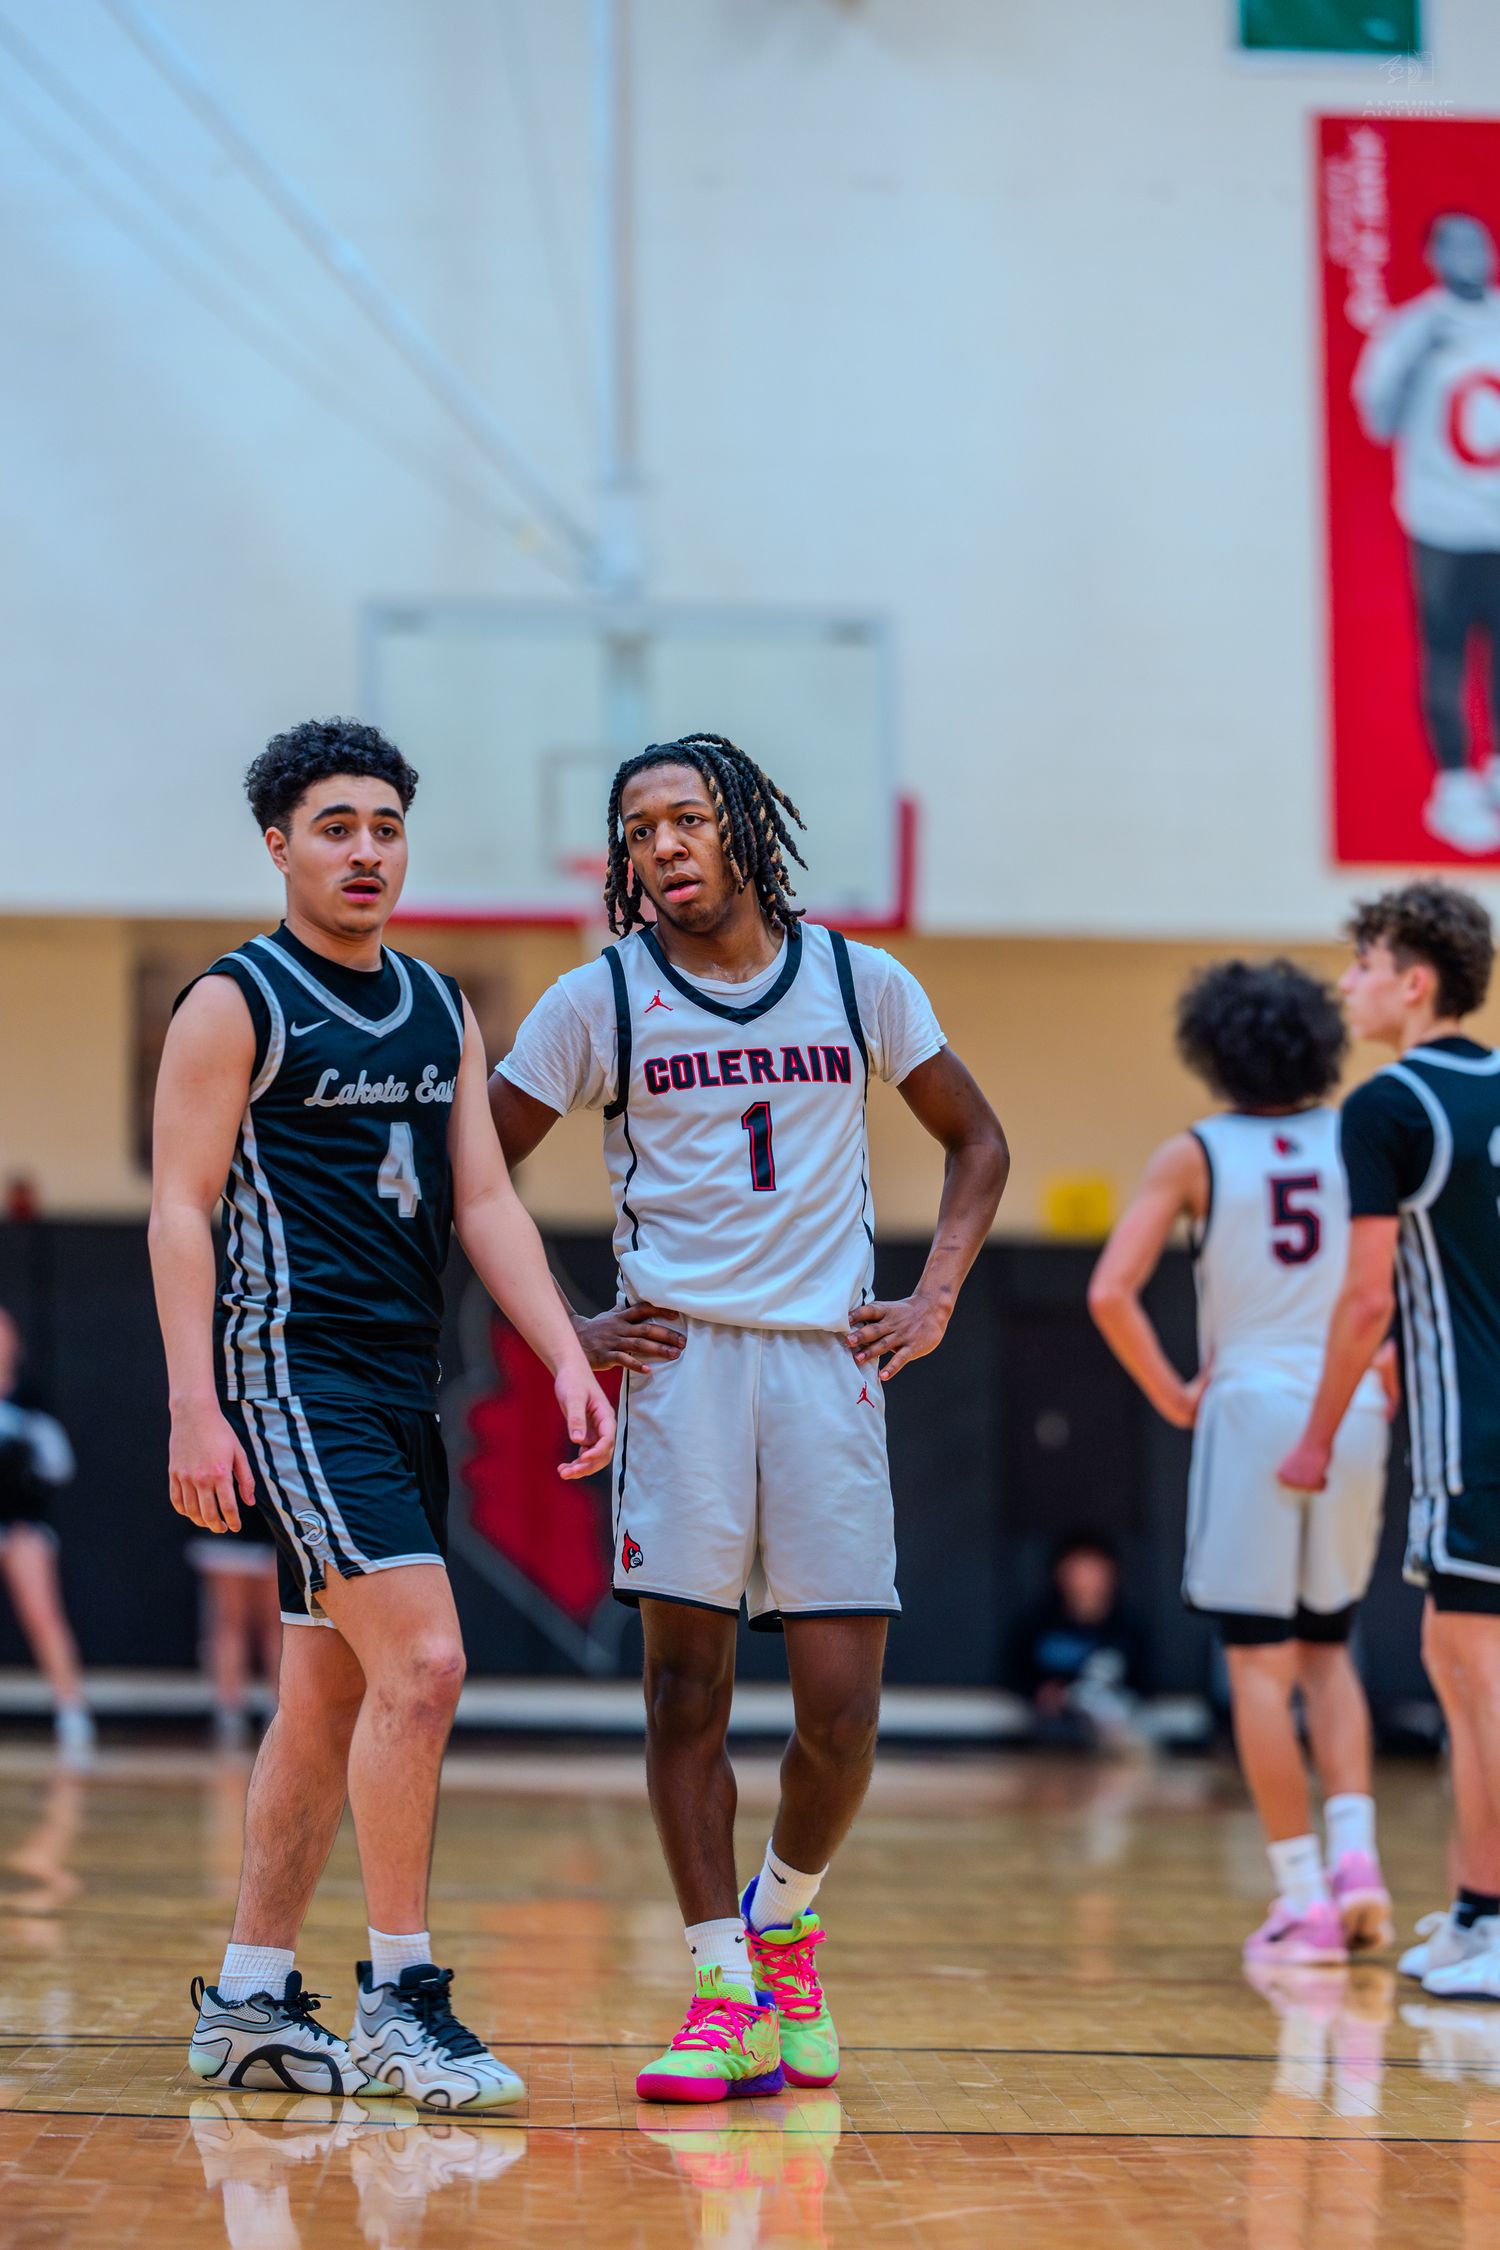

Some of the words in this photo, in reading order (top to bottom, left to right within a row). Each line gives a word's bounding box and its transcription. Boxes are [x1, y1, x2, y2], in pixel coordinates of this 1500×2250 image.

[304, 1067, 409, 1107] Lakota
[644, 1045, 851, 1095] COLERAIN
[377, 1122, 422, 1218] 4
[741, 1101, 776, 1191] 1
[1267, 1172, 1321, 1266] 5
